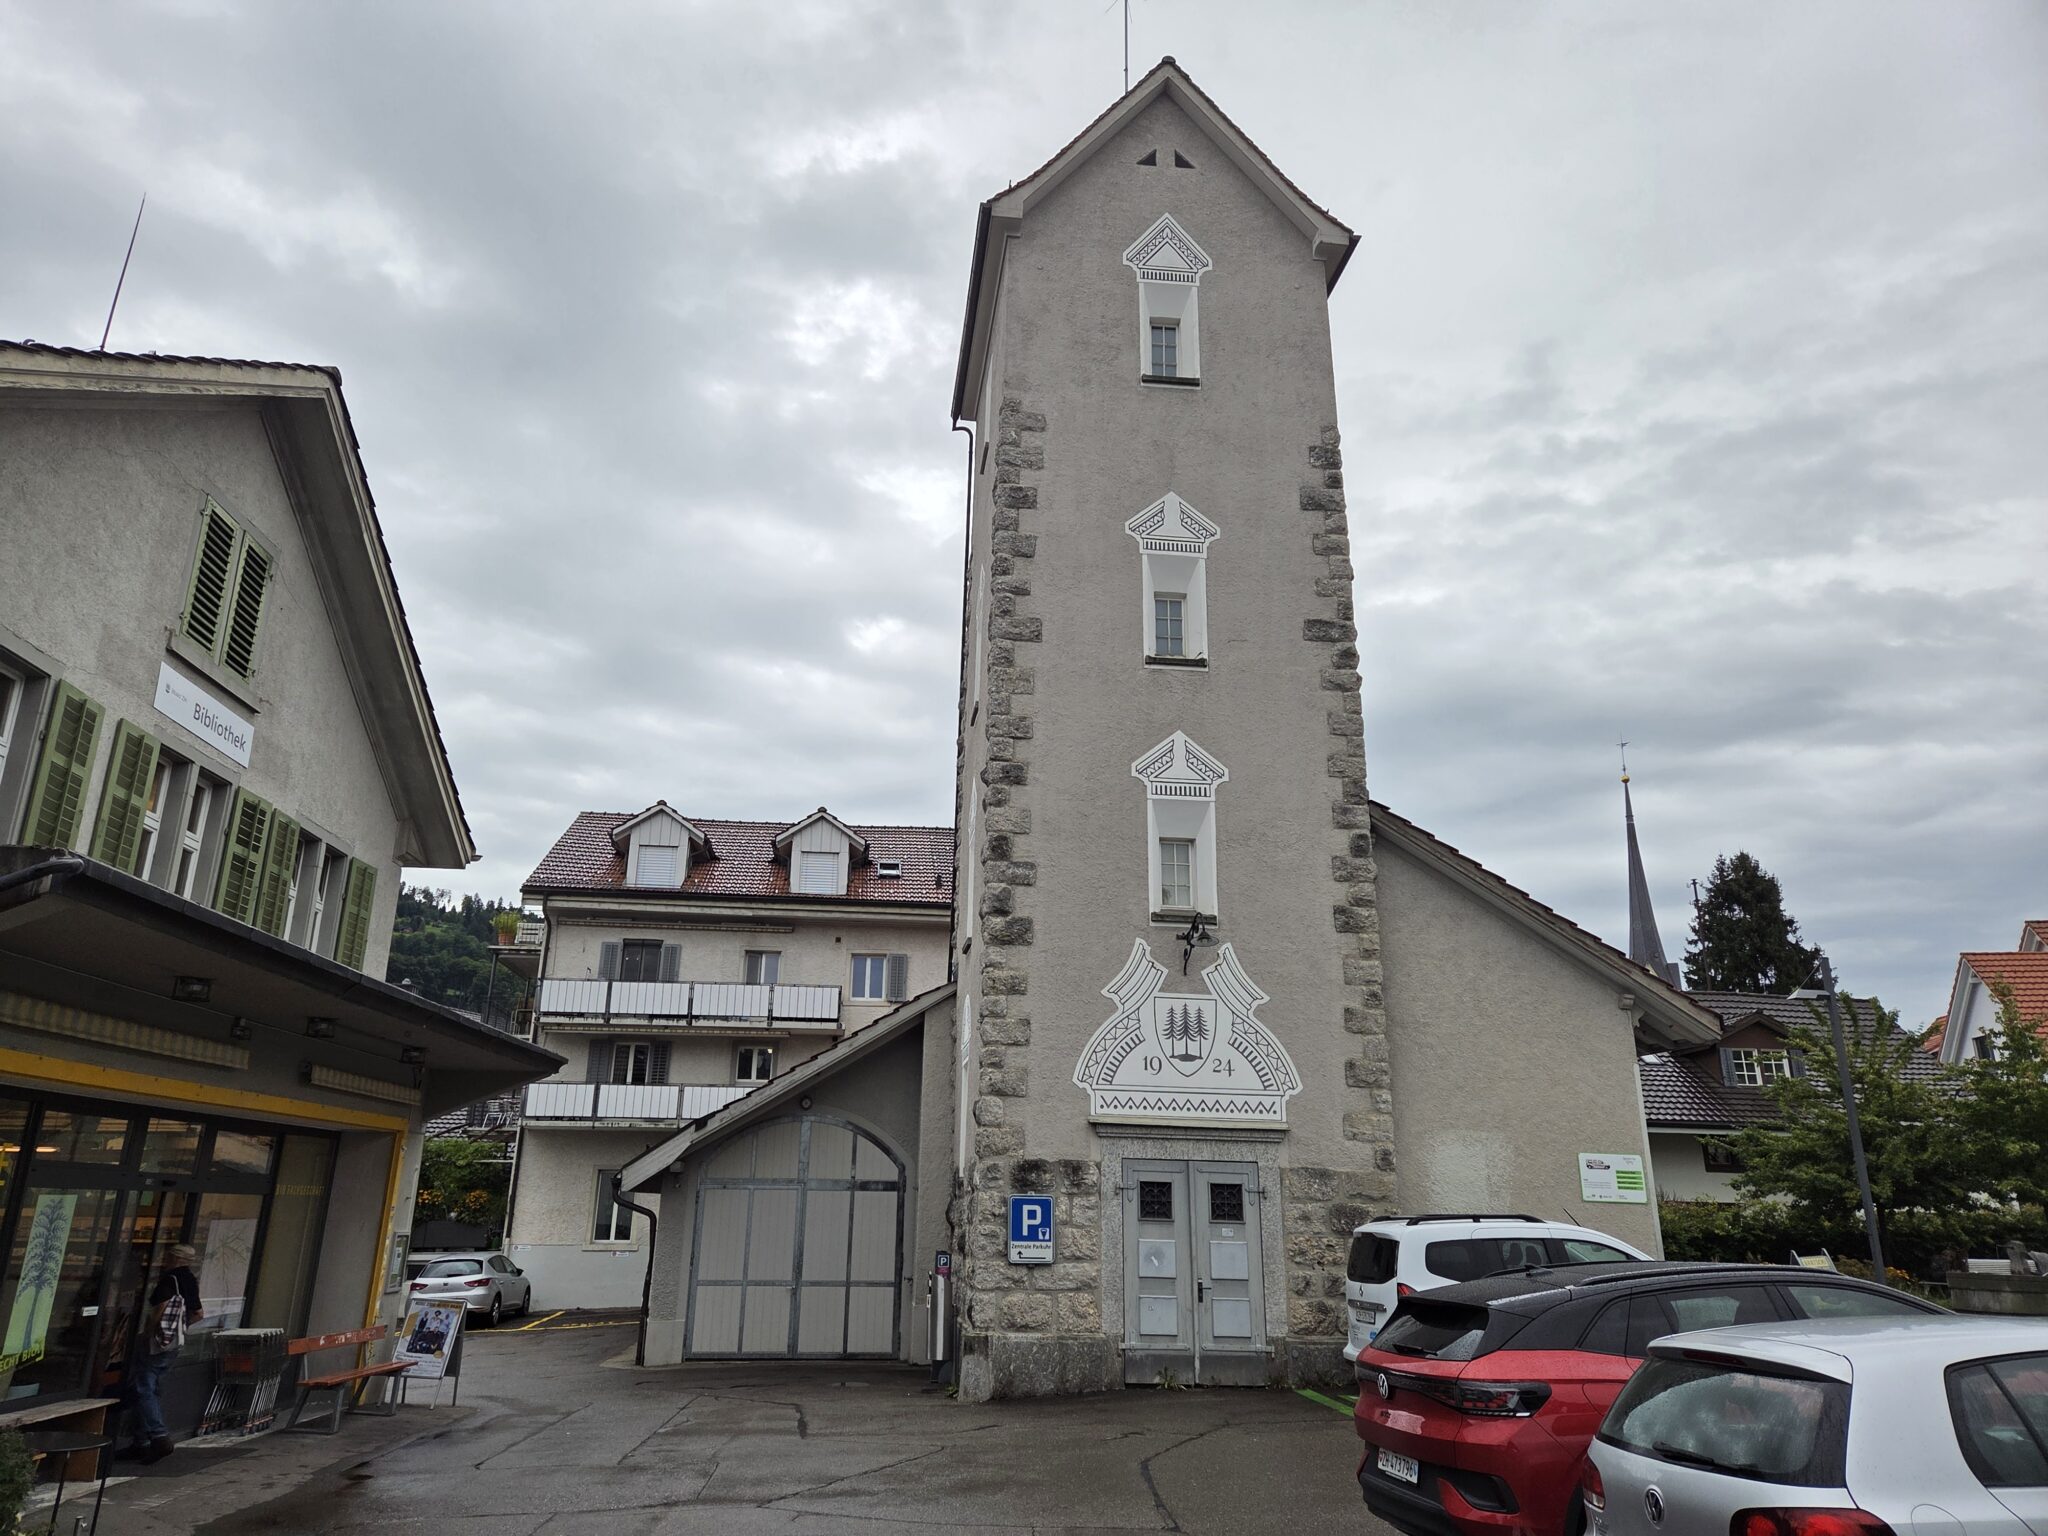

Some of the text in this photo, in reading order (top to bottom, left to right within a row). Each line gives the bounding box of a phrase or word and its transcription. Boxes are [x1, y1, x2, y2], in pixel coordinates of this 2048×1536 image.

[193, 702, 247, 752] Bibliothek
[1142, 1055, 1236, 1078] 19 24
[1022, 1204, 1042, 1237] P
[940, 1257, 947, 1266] P
